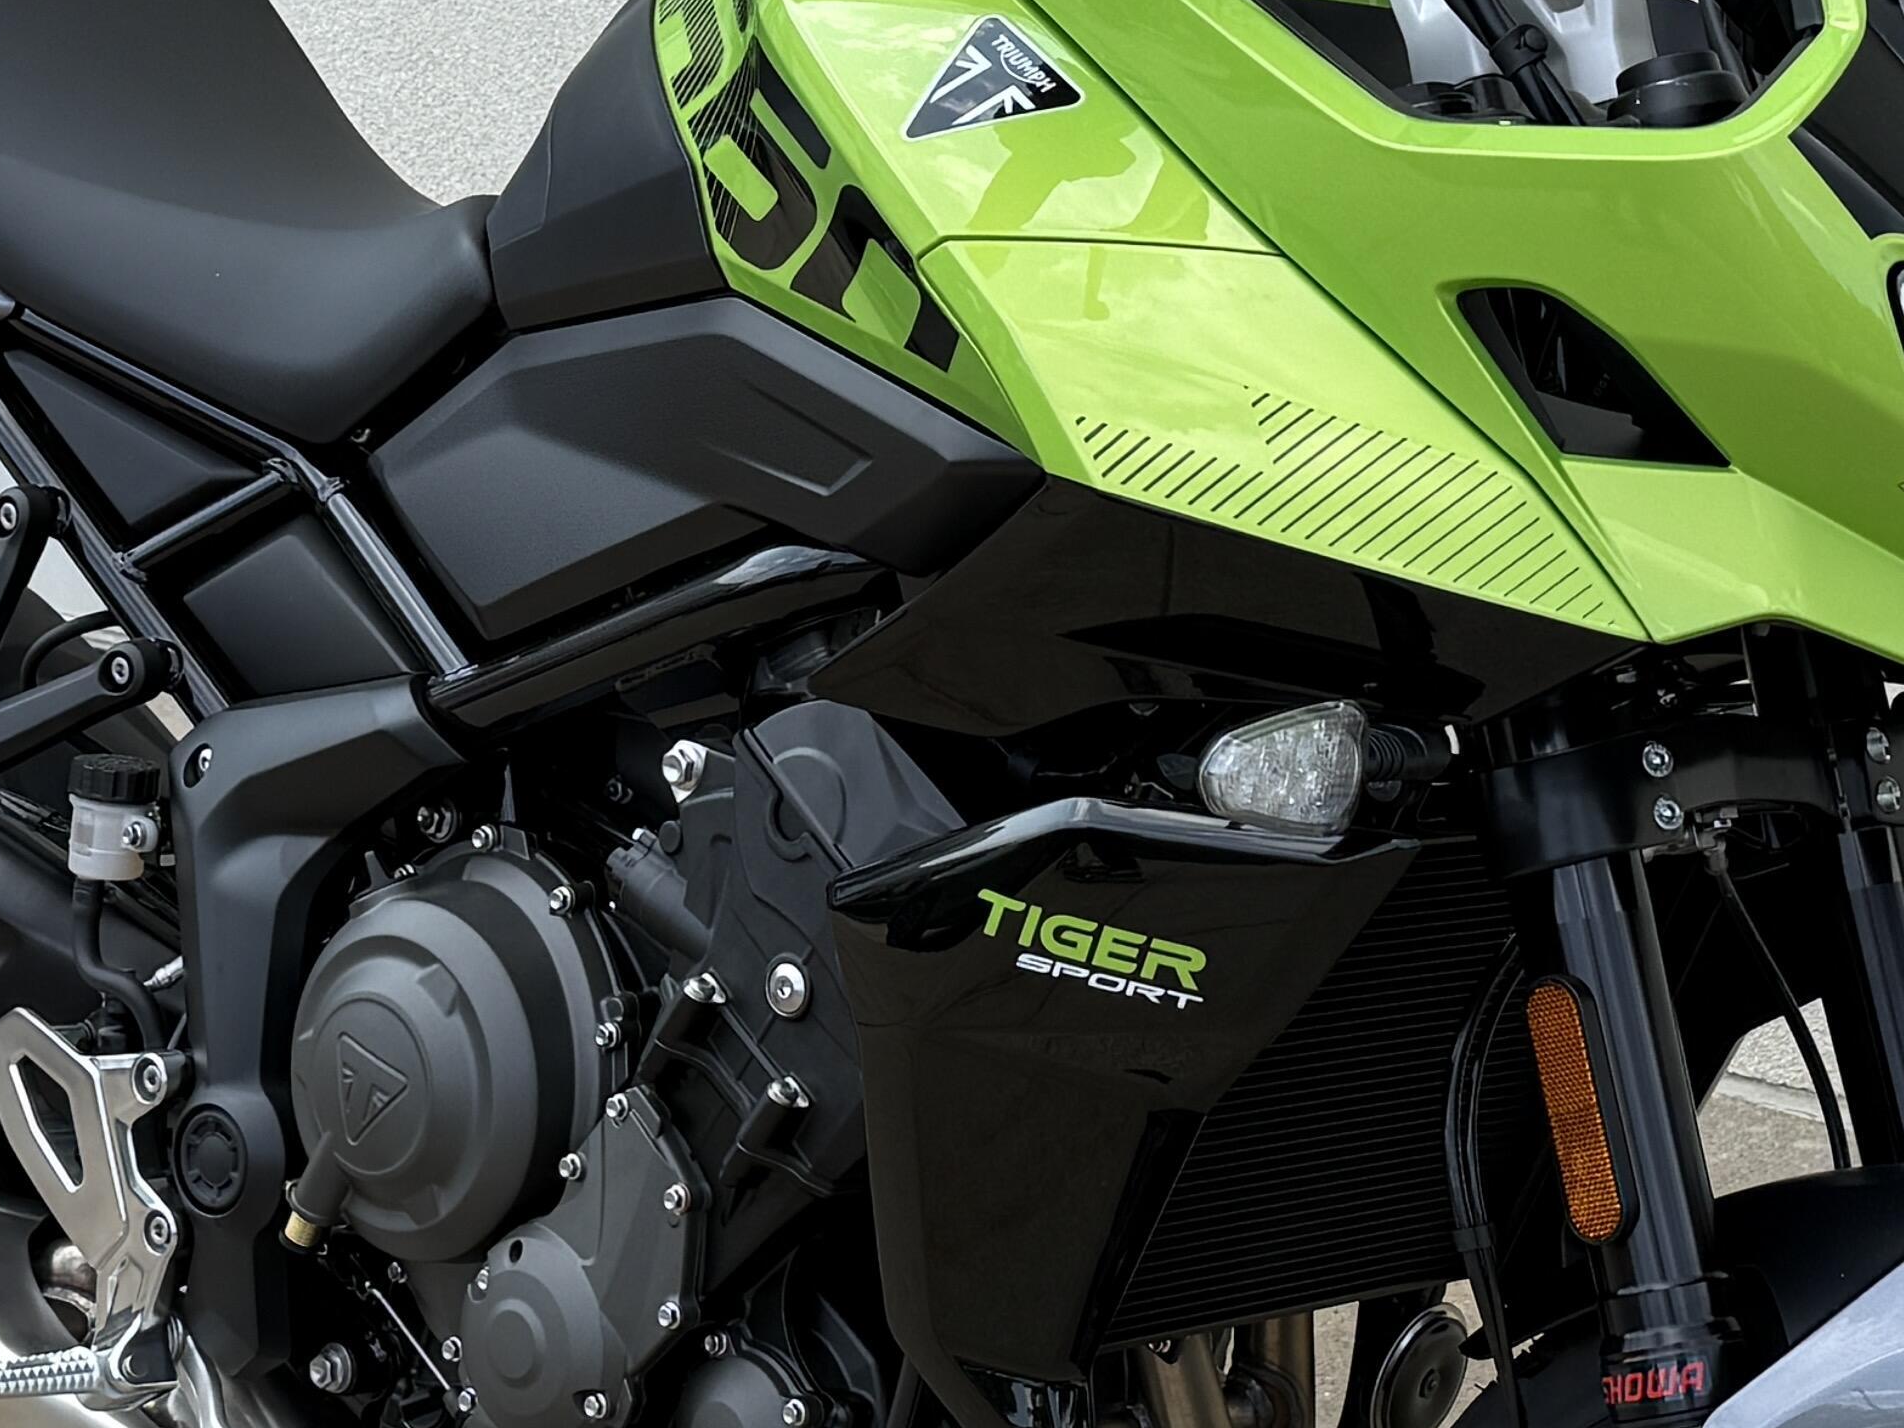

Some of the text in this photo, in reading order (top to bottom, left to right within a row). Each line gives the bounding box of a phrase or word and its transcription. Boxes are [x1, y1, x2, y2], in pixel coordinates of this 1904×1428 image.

[991, 34, 1057, 93] TRIUMPH
[977, 888, 1207, 991] TIGER
[1016, 953, 1204, 1009] SPORT
